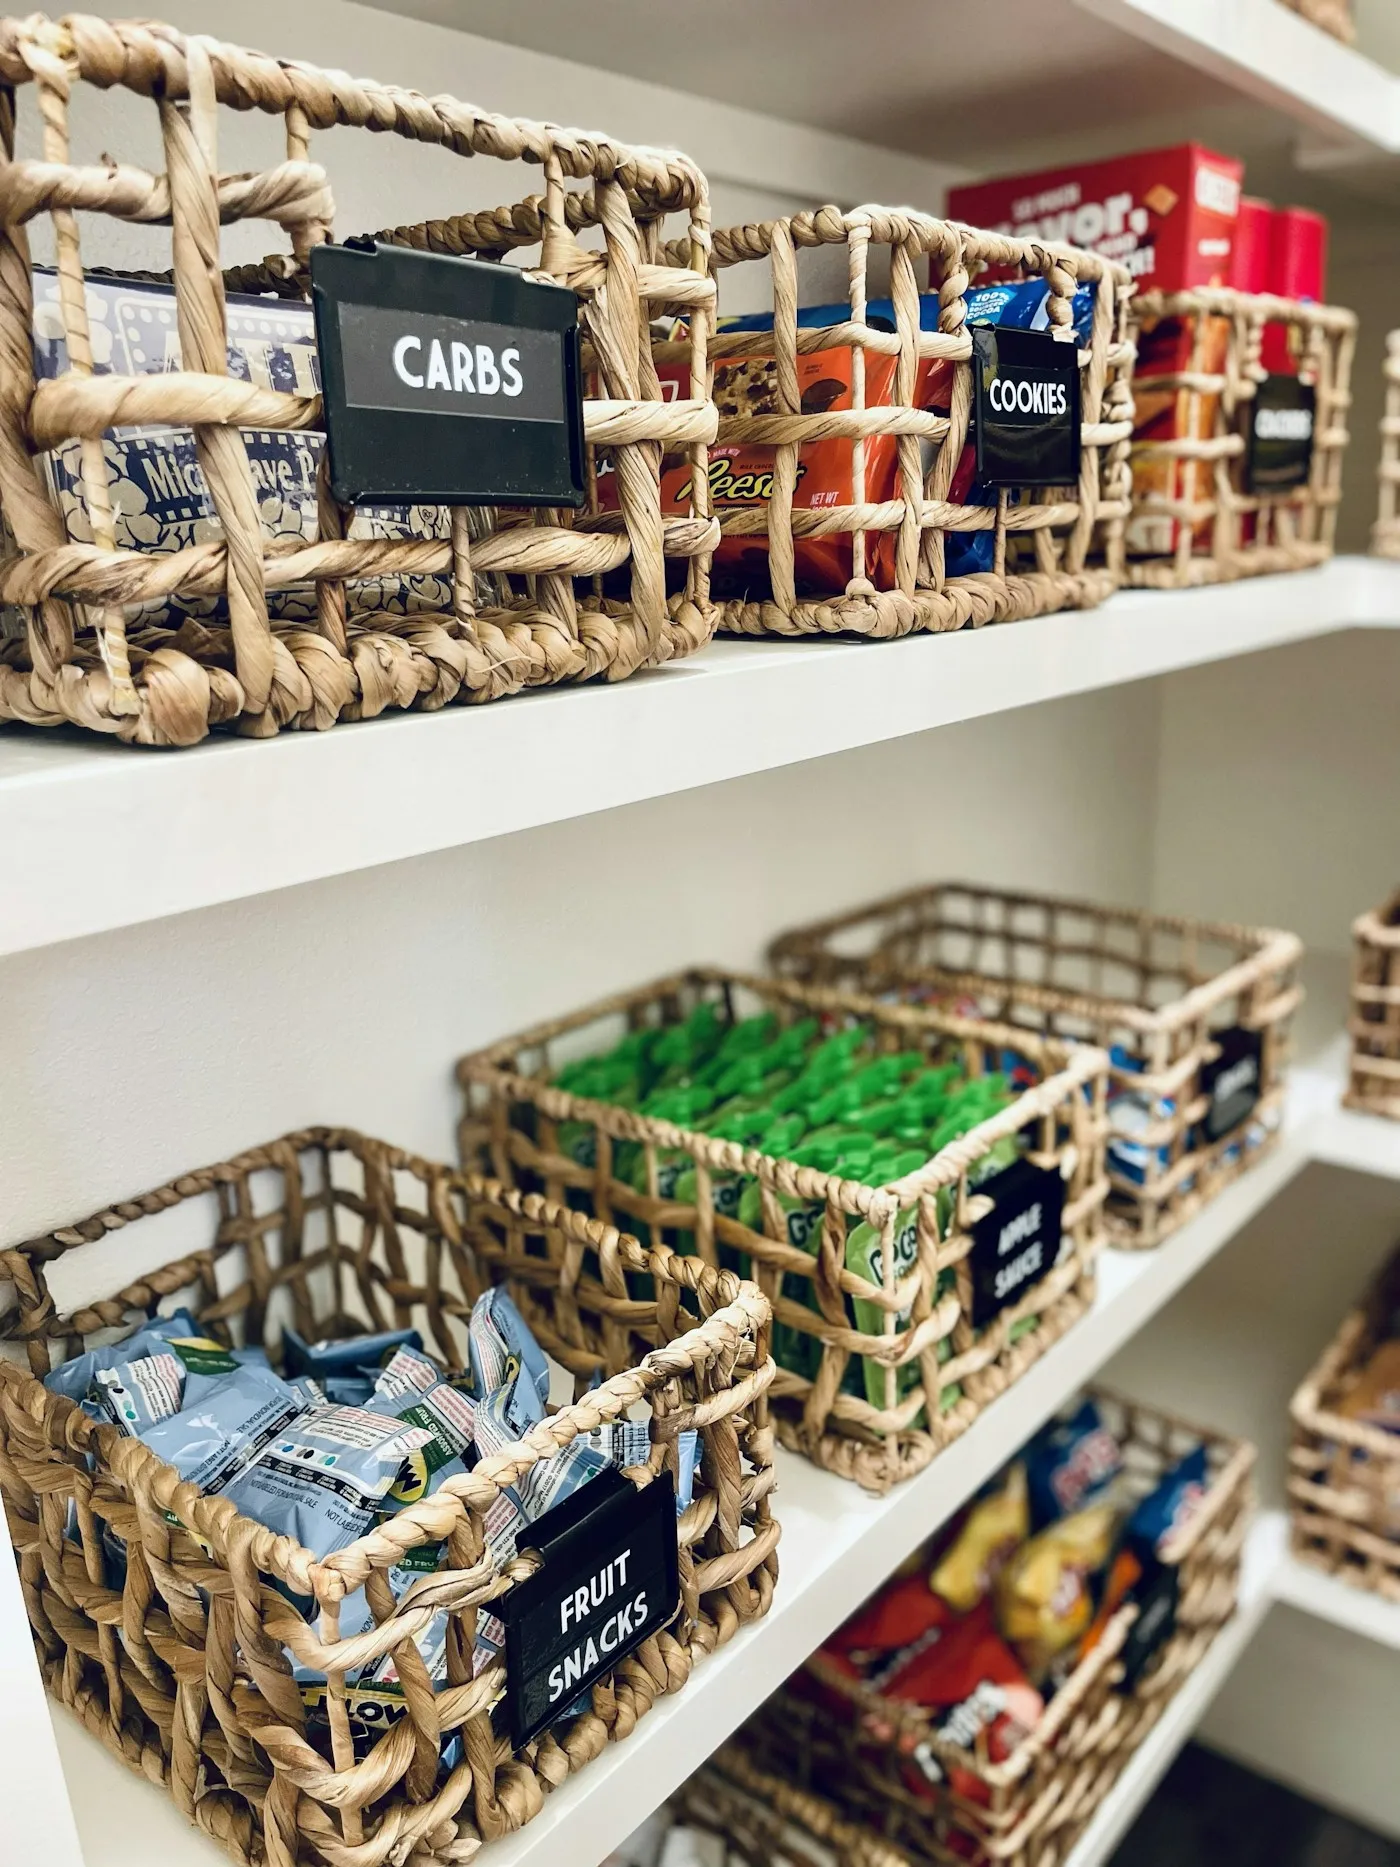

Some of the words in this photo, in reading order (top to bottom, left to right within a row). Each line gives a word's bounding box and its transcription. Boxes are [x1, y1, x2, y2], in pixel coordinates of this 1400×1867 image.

[393, 335, 524, 397] CARBS
[990, 378, 1067, 415] COOKIES
[141, 453, 293, 502] Micave
[810, 493, 825, 505] NET
[825, 491, 839, 504] WT
[560, 1549, 631, 1634] FRUIT
[548, 1592, 649, 1702] SNACKS
